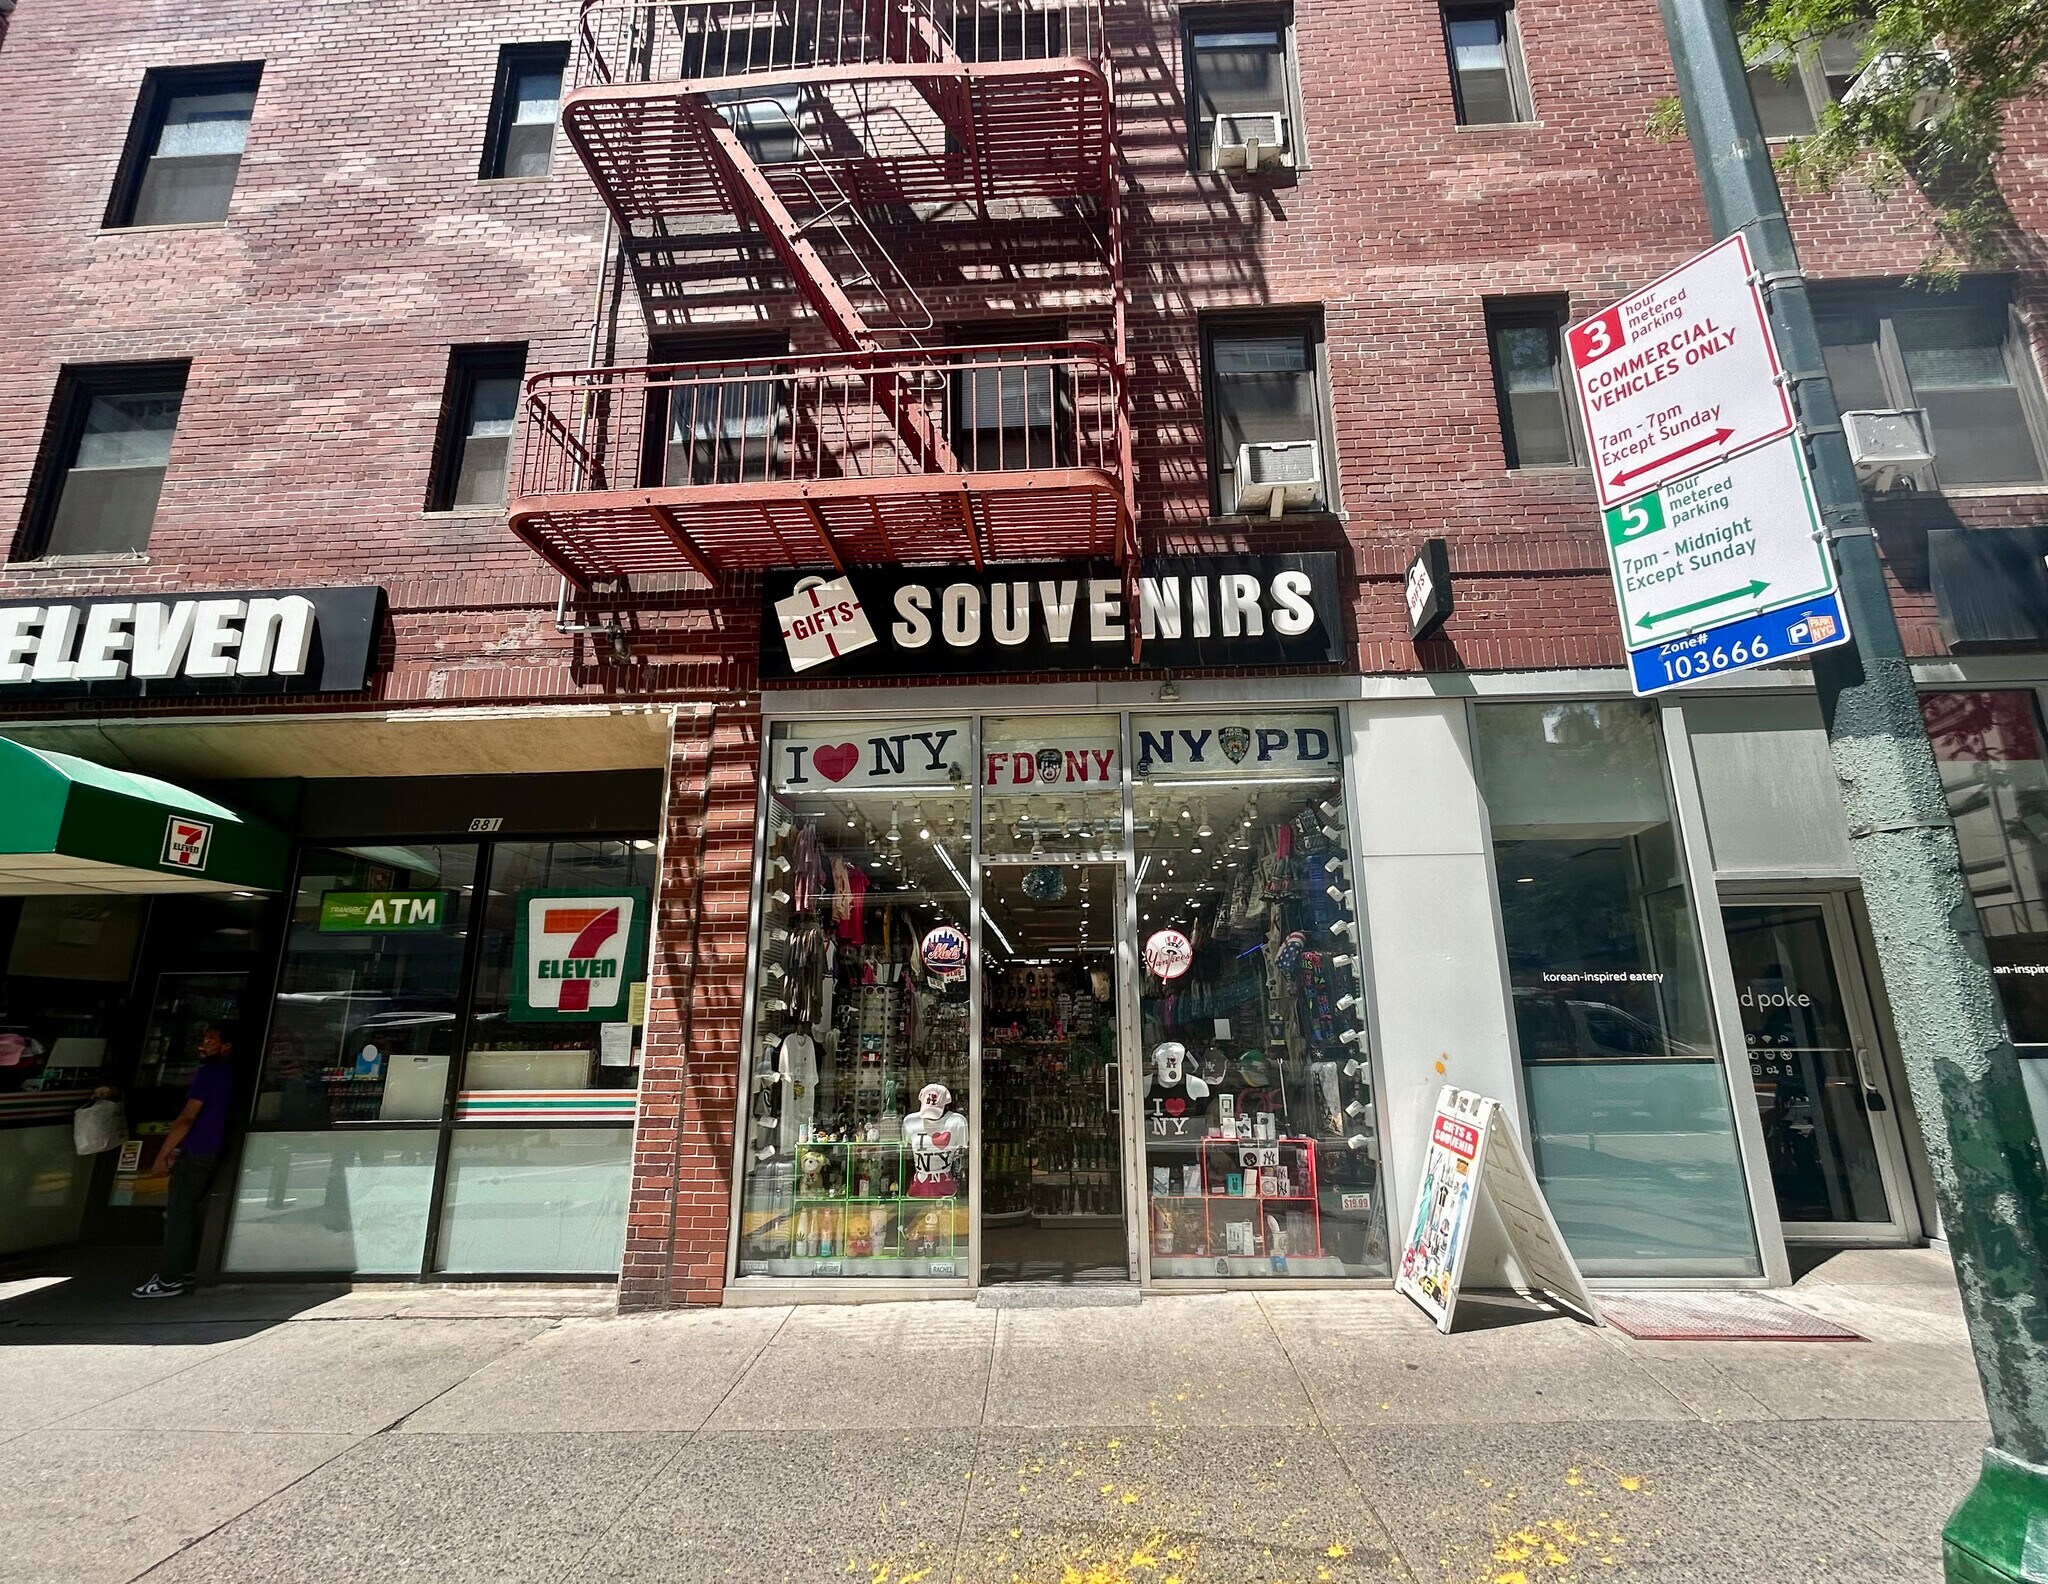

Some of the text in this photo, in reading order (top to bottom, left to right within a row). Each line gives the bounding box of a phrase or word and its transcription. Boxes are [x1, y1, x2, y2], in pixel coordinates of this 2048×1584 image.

[1625, 292, 1656, 316] hour
[1628, 288, 1687, 328] metered
[1582, 320, 1611, 358] 3
[1631, 306, 1683, 343] parking
[1587, 317, 1719, 394] COMMERCIAL
[1591, 327, 1736, 412] VEHICLES ONLY
[1599, 427, 1633, 450] 7am
[1646, 404, 1682, 428] 7pm
[1602, 404, 1721, 467] Except Sunday
[1666, 476, 1700, 497] hour
[1669, 476, 1733, 511] metered
[1620, 497, 1649, 537] 5
[1672, 495, 1729, 528] parking
[1623, 552, 1659, 575] 7pm
[1674, 516, 1753, 557] Midnight
[1626, 538, 1756, 593] Except Sunday
[792, 601, 854, 641] GIFTS
[892, 570, 1315, 649] SOUVENIRS
[1810, 616, 1832, 629] PARK
[1660, 632, 1709, 656] Zone#
[1812, 624, 1835, 643] NYC
[1663, 635, 1769, 682] 103666
[785, 729, 957, 784] I NY
[471, 819, 499, 831] 881
[177, 825, 203, 864] 7
[365, 898, 436, 925] ATM
[543, 906, 619, 1011] 7
[928, 943, 961, 960] Mets
[1542, 971, 1664, 984] korean-inspired eatery
[1757, 986, 1811, 1013] poke
[1152, 1098, 1163, 1116] I
[917, 1133, 927, 1151] I
[1434, 1128, 1475, 1155] SOUVENIR
[1442, 1119, 1466, 1138] GIFTS
[915, 1151, 952, 1172] NY
